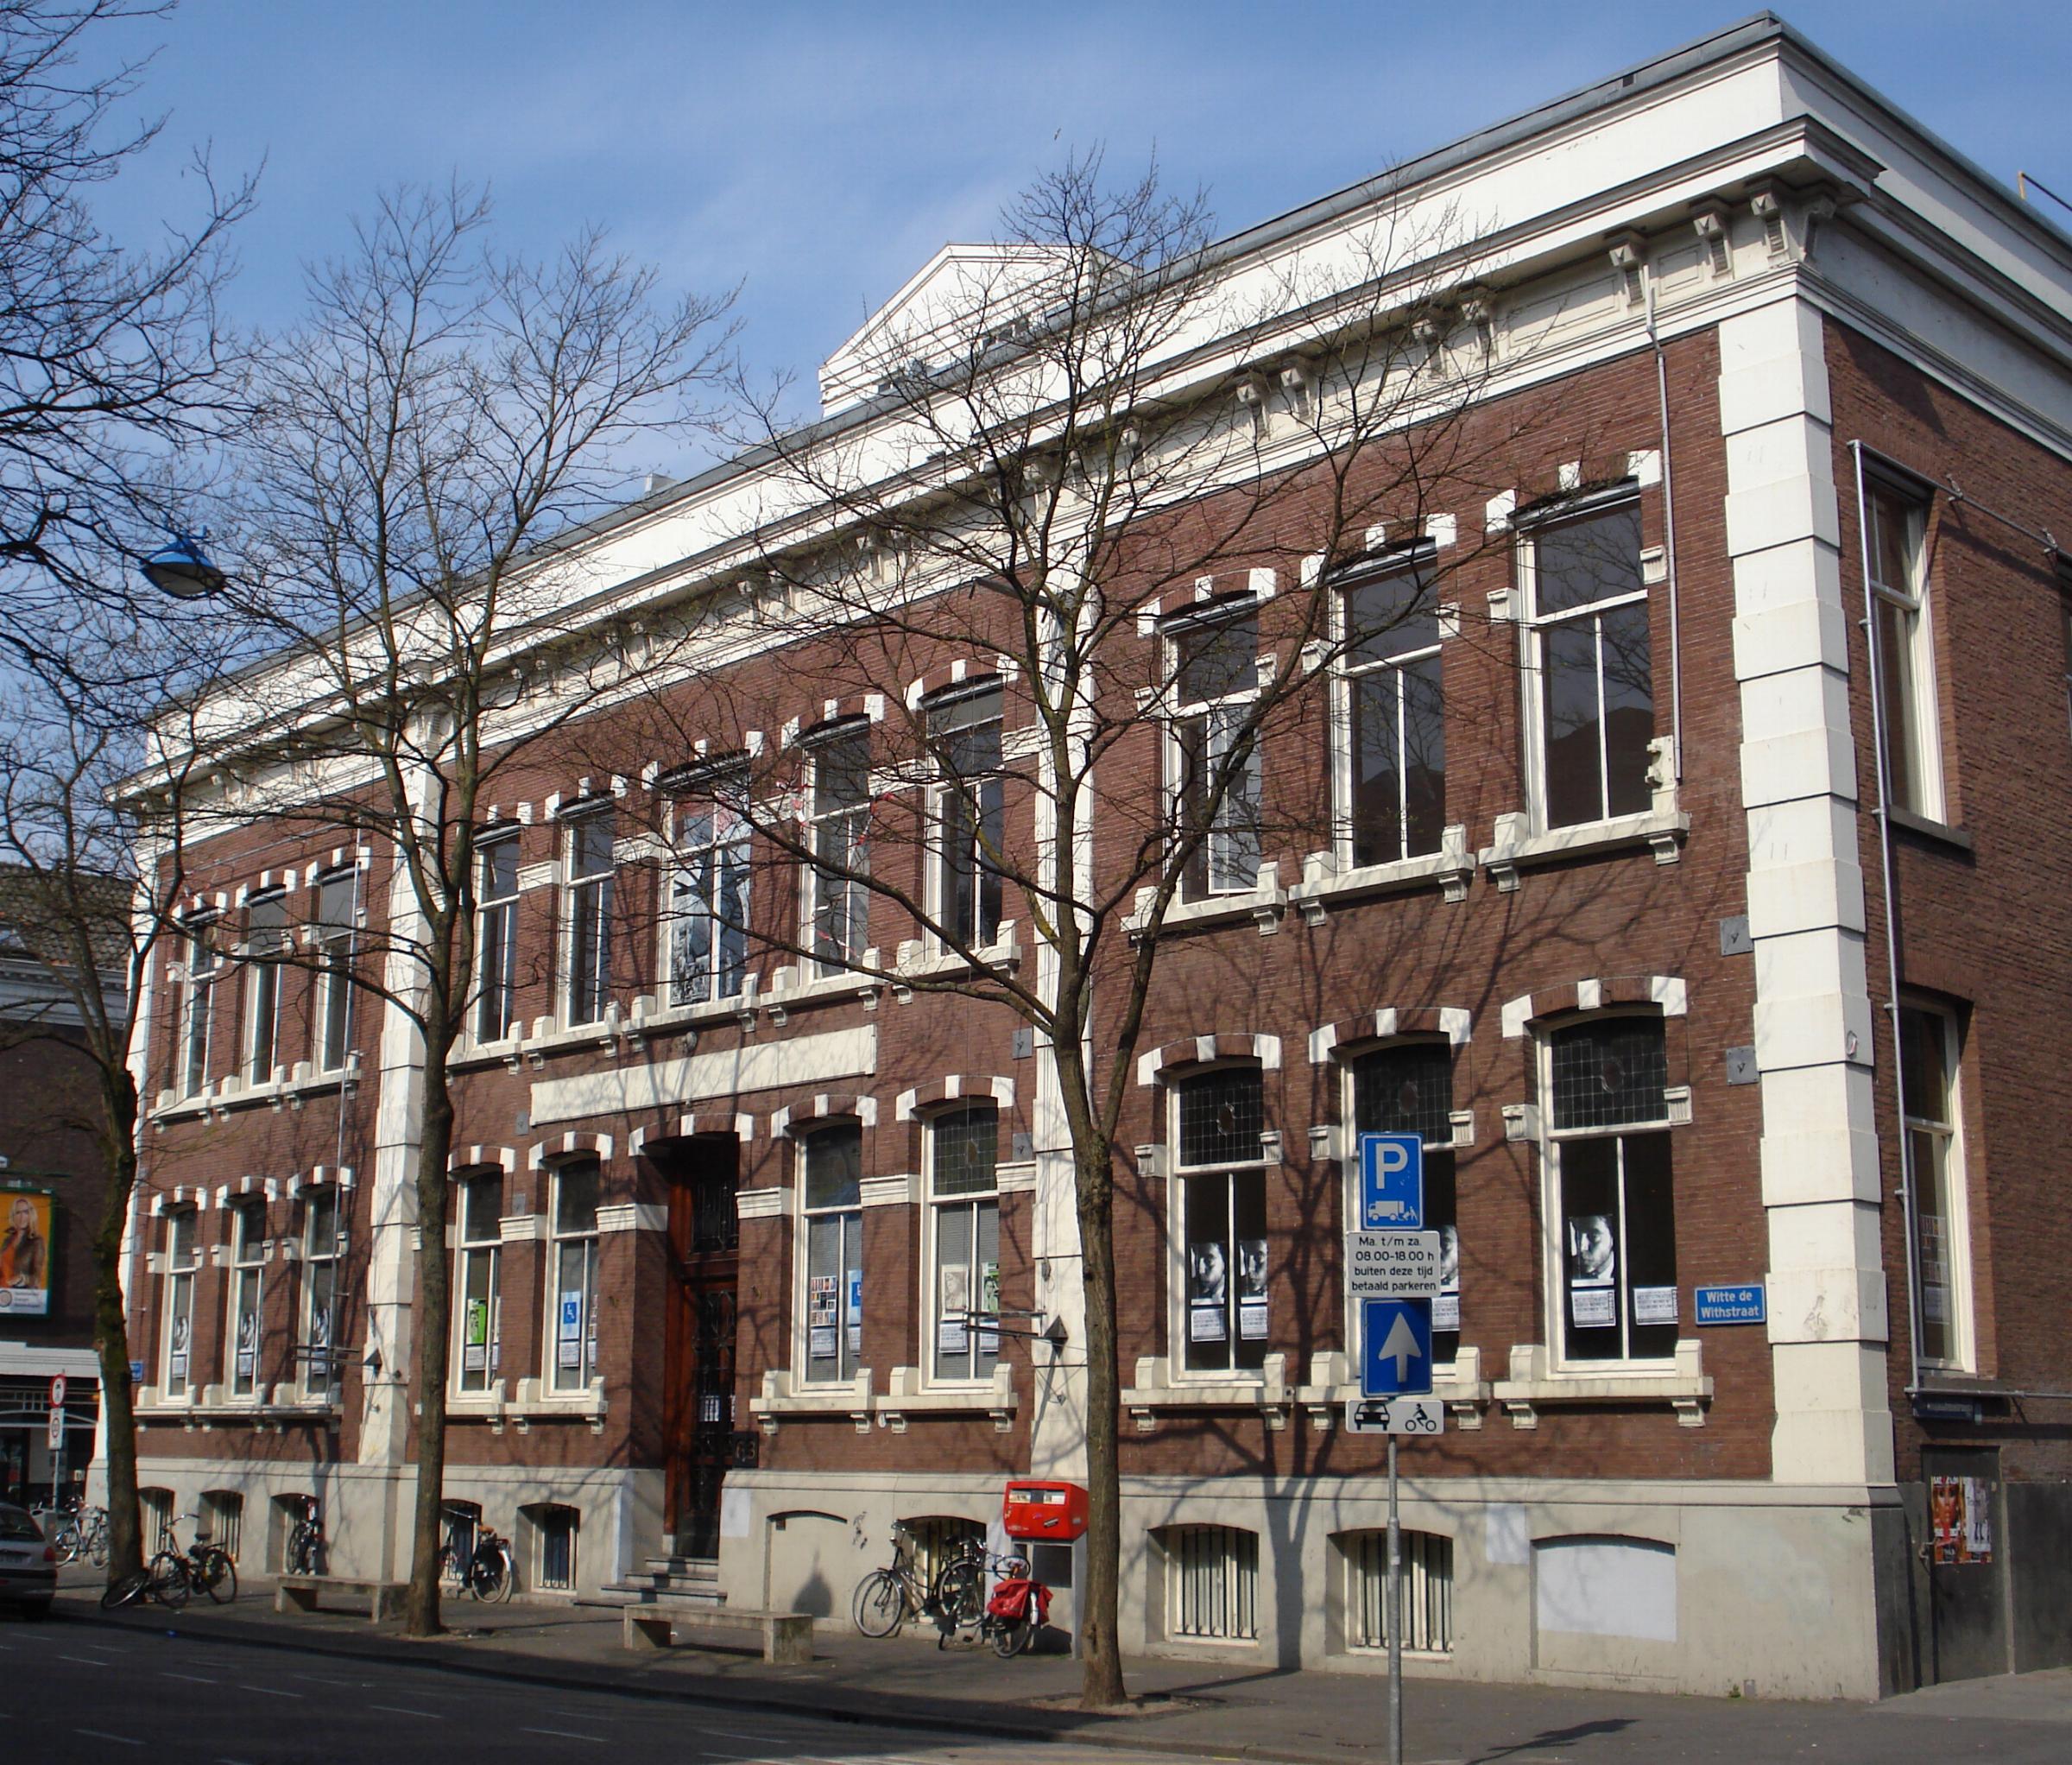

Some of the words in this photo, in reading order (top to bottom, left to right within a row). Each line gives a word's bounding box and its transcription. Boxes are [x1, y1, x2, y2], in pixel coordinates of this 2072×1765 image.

[1375, 1142, 1408, 1189] P
[1381, 1236, 1404, 1247] t/m
[1355, 1250, 1424, 1262] 08.00-18.00
[1427, 1251, 1435, 1262] h
[1355, 1266, 1387, 1276] buiten
[1389, 1266, 1413, 1276] deze
[1417, 1266, 1433, 1279] tijd
[1351, 1281, 1389, 1291] betaald
[1392, 1281, 1437, 1293] parkeren
[1706, 1291, 1736, 1304] Witte
[1739, 1290, 1753, 1302] de
[1701, 1305, 1759, 1319] Withstraat
